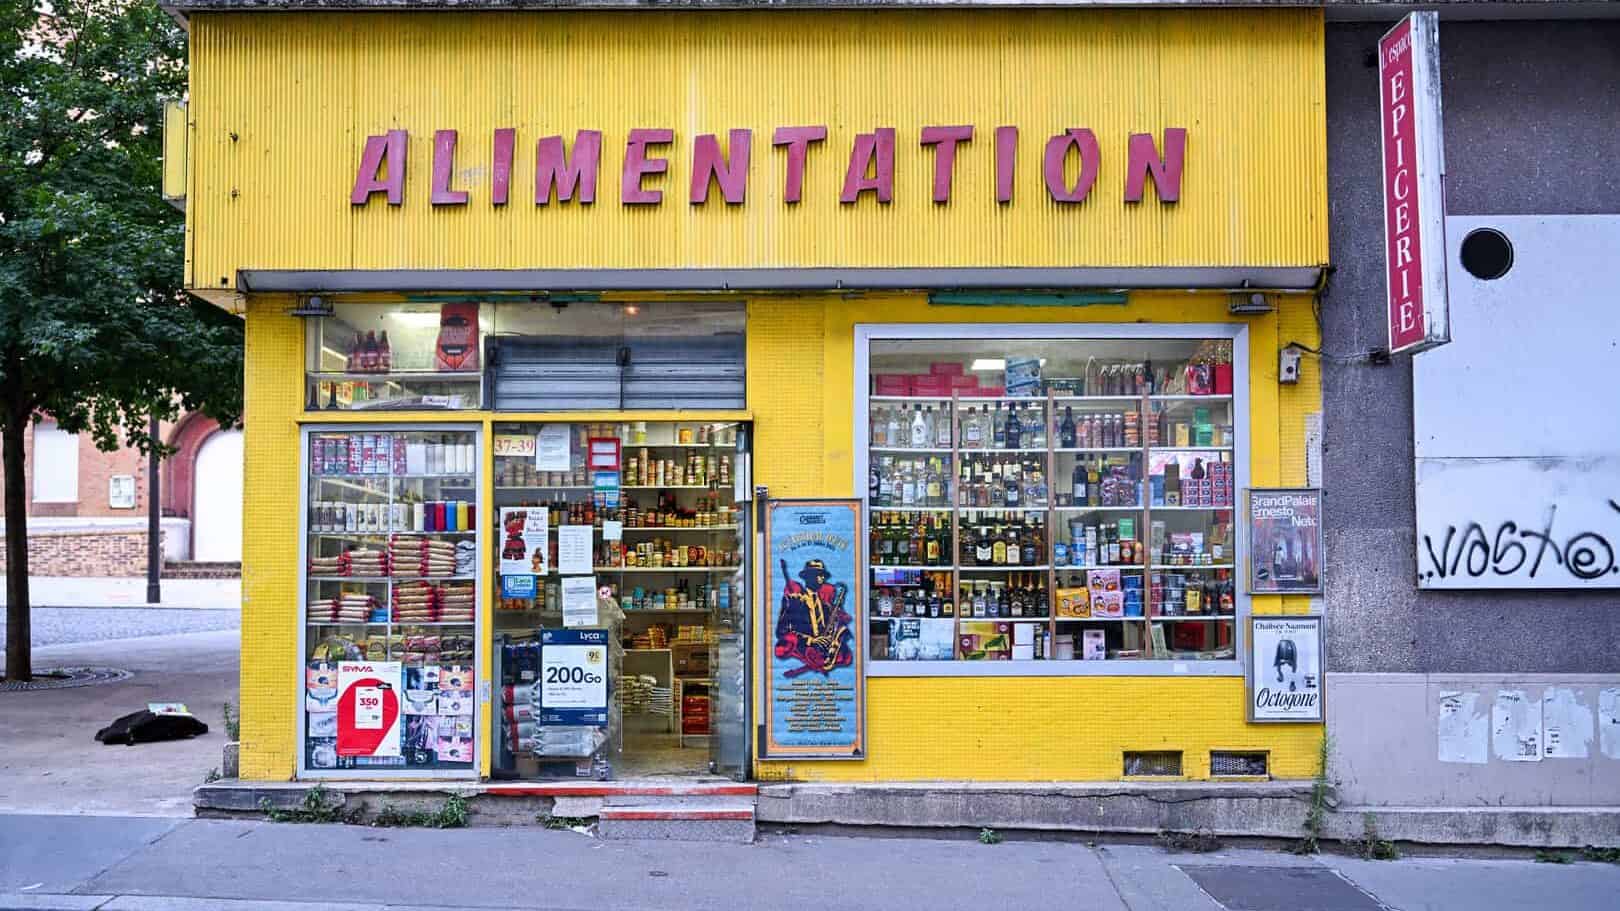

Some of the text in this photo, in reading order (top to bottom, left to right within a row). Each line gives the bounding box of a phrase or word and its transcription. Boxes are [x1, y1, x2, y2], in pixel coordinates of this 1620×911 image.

[351, 126, 1188, 206] ALIMENTATION
[1391, 70, 1415, 332] EPICERIE
[580, 632, 600, 640] Lyca
[546, 666, 602, 684] 200Go
[359, 697, 378, 706] 350
[1256, 687, 1318, 711] Octogone
